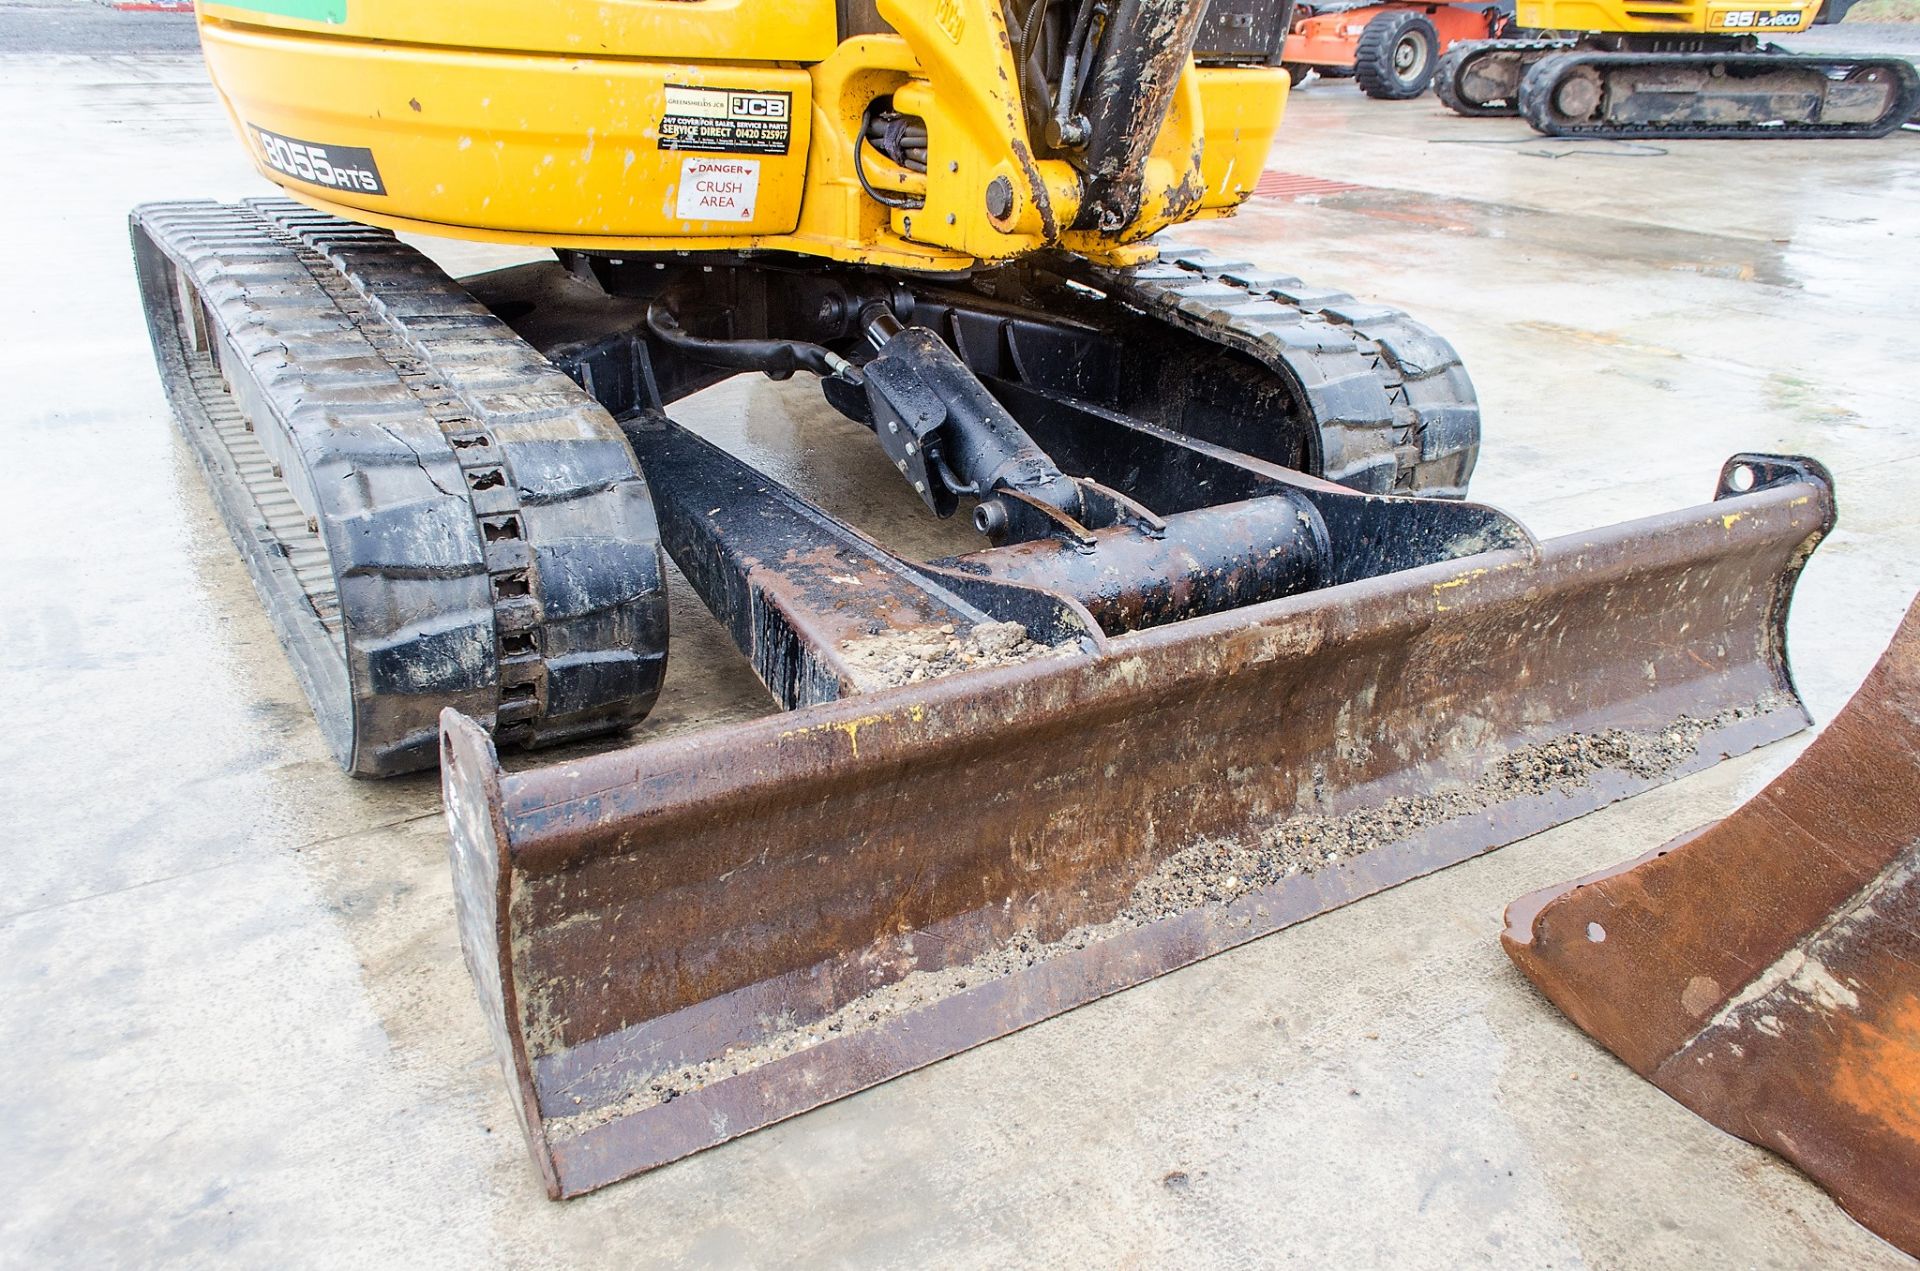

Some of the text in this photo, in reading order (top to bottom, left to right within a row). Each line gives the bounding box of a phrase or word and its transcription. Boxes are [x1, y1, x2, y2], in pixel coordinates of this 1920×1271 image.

[1724, 11, 1755, 27] 85
[667, 98, 725, 109] GREENSHIELDS JCB
[733, 97, 785, 117] JCB
[677, 117, 699, 126] COVER
[700, 118, 714, 126] FOR
[736, 121, 762, 129] SERVICE
[663, 124, 699, 135] SERVICE
[700, 127, 732, 137] DIRECT
[735, 128, 760, 138] 01420
[698, 164, 743, 174] DANGER
[696, 180, 743, 194] CRUSH
[699, 195, 735, 208] AREA
